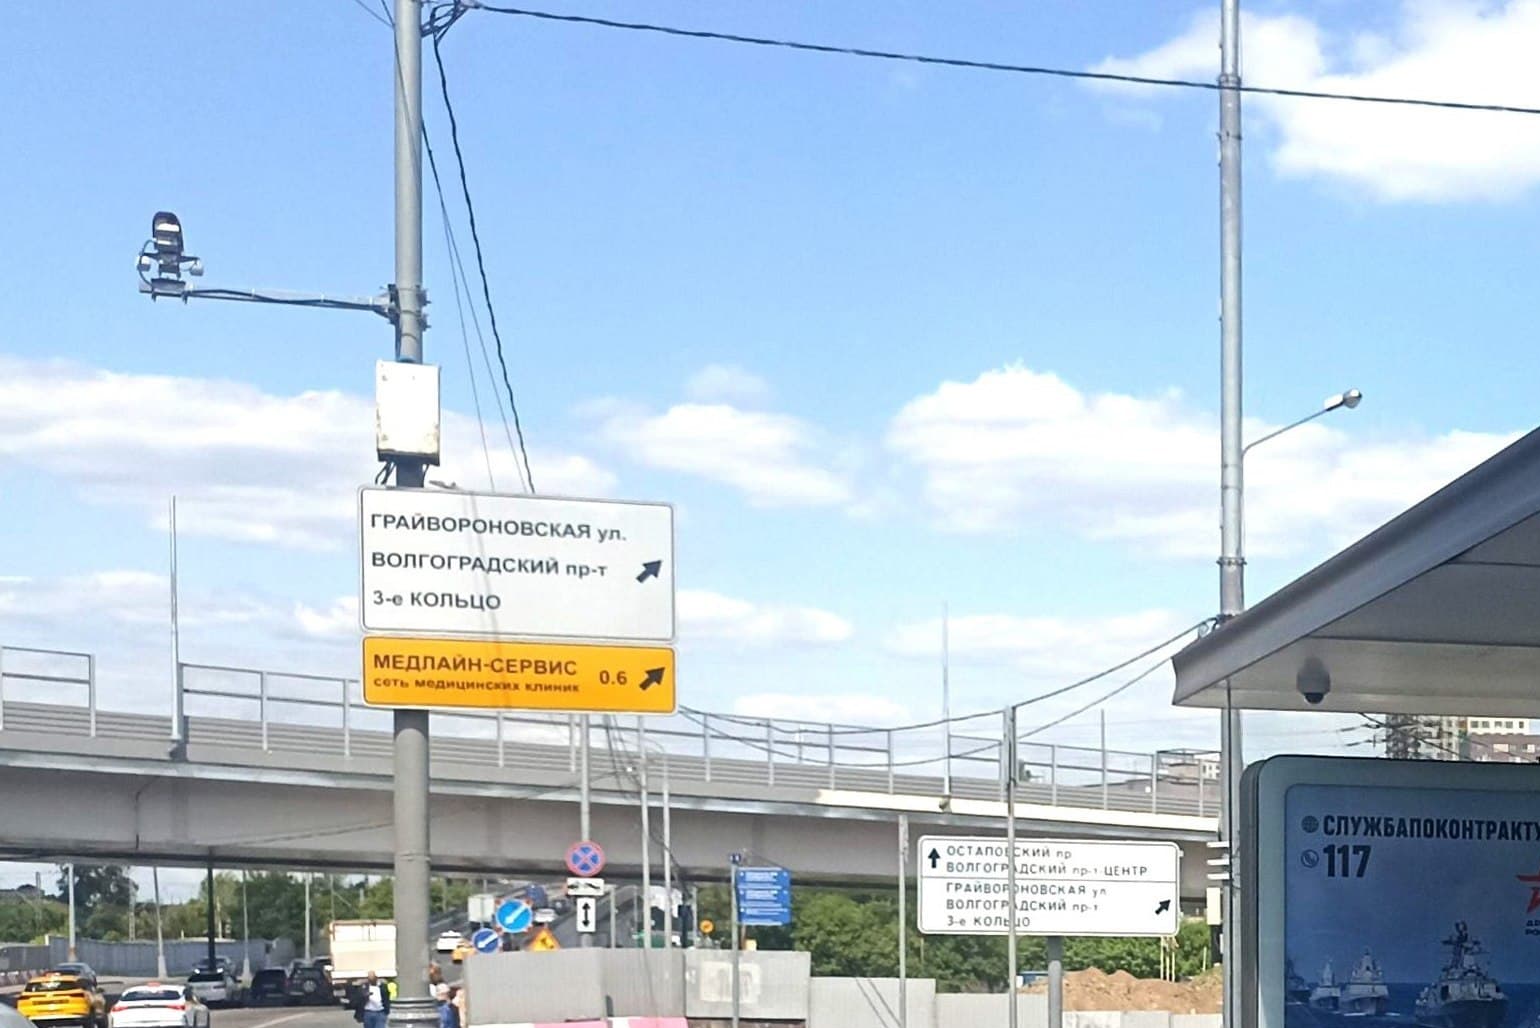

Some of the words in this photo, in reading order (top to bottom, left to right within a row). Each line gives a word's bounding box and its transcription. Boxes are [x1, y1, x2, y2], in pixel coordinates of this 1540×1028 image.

[370, 512, 590, 539] ГРАЙВОРОНОВСКАЯ
[597, 526, 627, 542] ул.
[372, 552, 559, 575] ВОЛГОГРАДСКИЙ
[566, 562, 607, 578] пр-т
[373, 590, 402, 606] 3-е
[410, 591, 501, 611] КОЛЬЦО
[374, 653, 577, 675] МЕДЛАЙН-СЕРВИС
[599, 669, 627, 686] 0.6
[374, 676, 409, 688] сеть
[415, 679, 519, 691] медицинских
[525, 682, 579, 693] клиник
[1056, 850, 1072, 859] пр
[1323, 844, 1371, 879] 117
[1104, 866, 1147, 876] ЦЕНТР
[948, 916, 966, 926] 3-е
